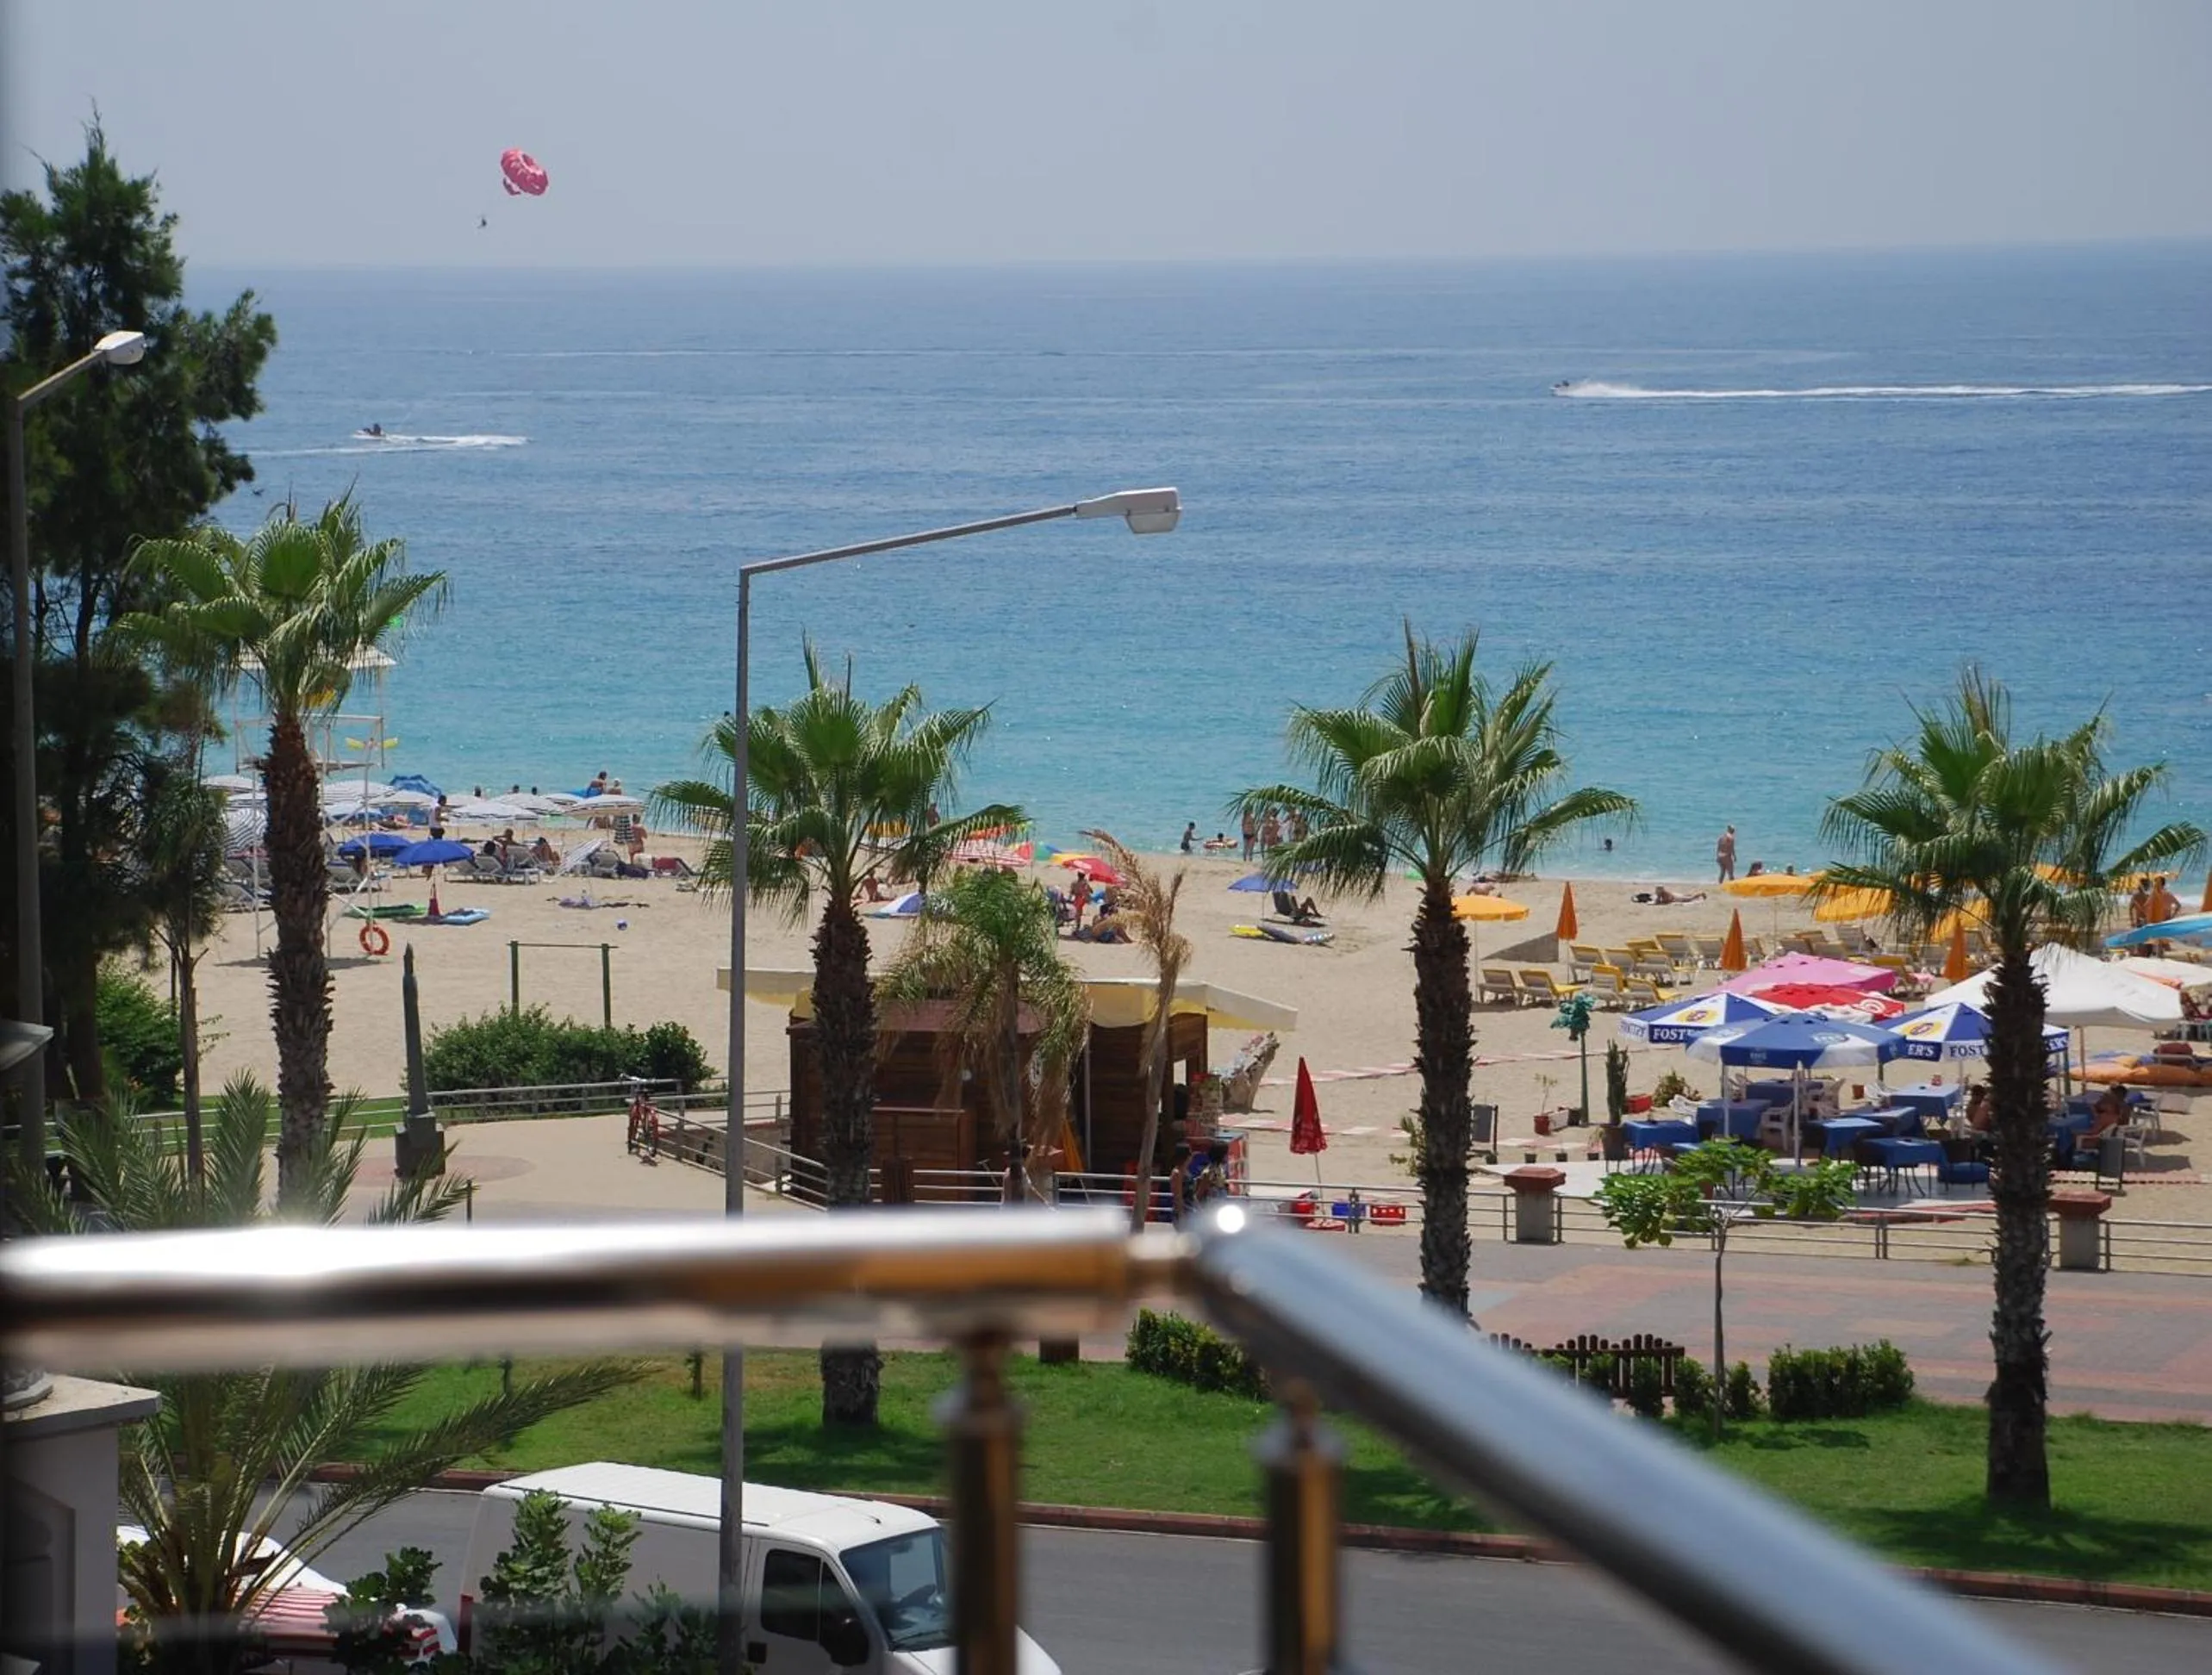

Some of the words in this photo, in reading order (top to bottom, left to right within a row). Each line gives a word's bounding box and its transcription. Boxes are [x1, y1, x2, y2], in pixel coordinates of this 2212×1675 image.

[1653, 1028, 1690, 1041] FOST
[1908, 1043, 1935, 1057] ER'S
[1949, 1044, 1985, 1058] FOST
